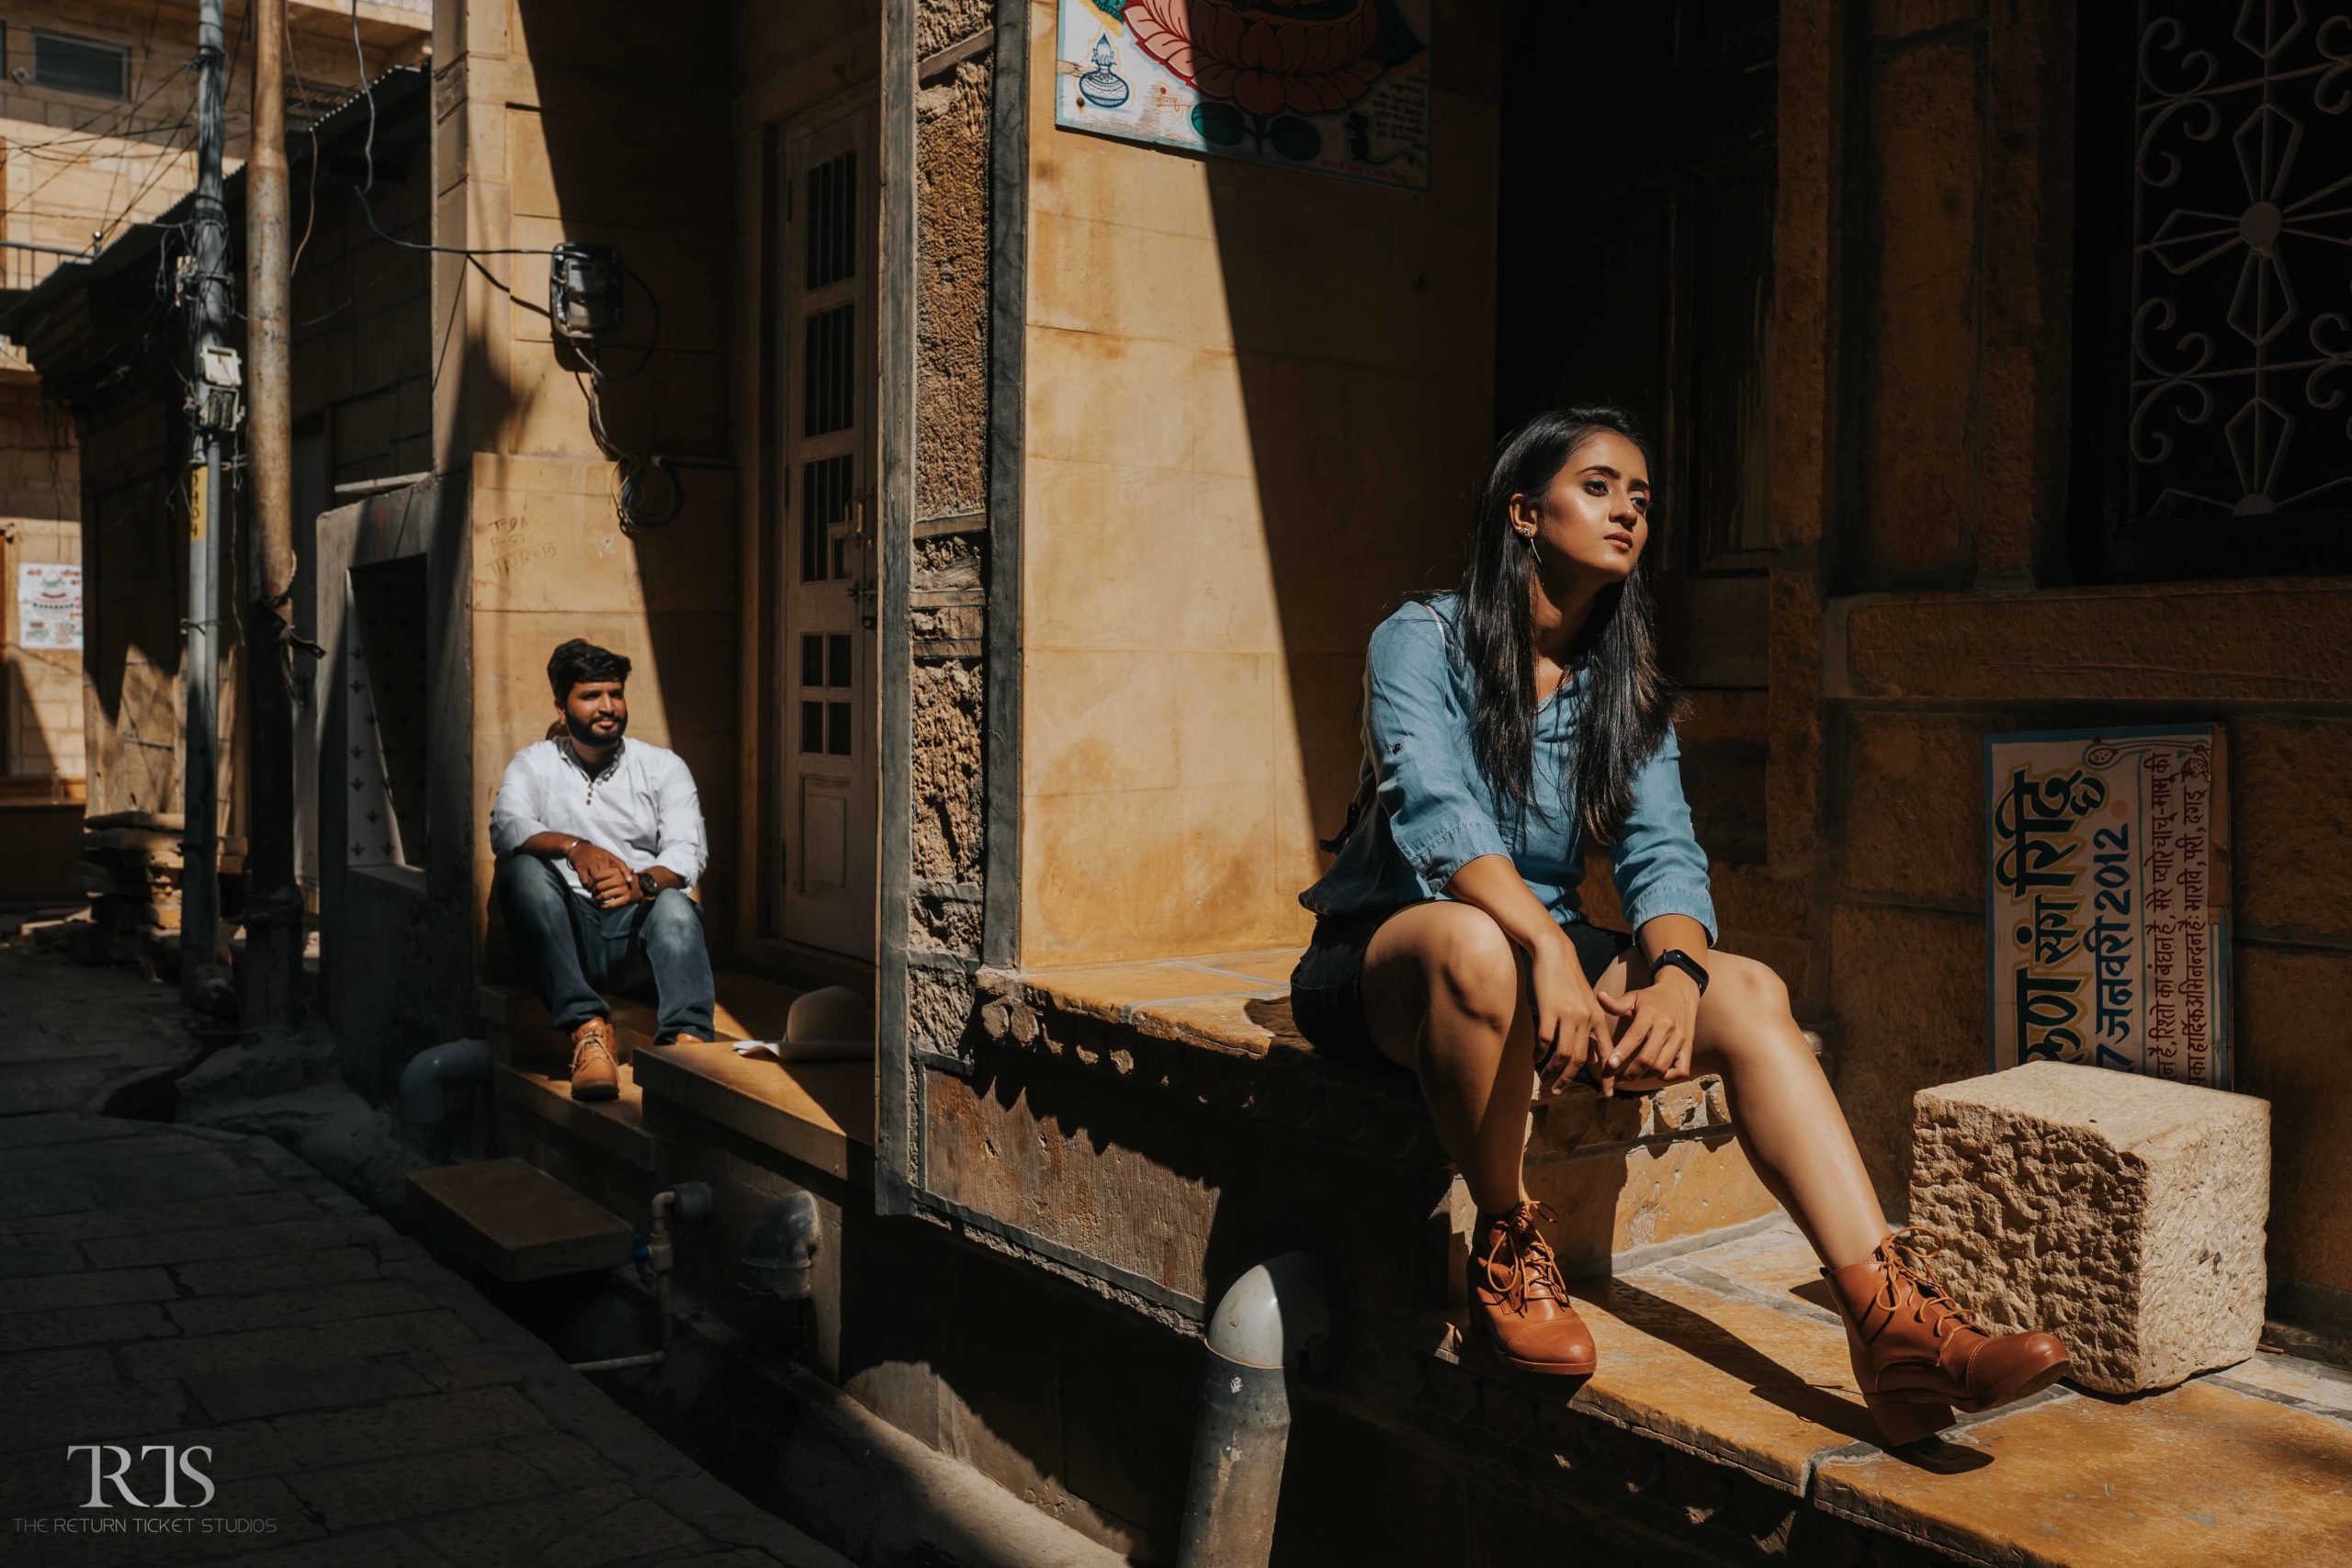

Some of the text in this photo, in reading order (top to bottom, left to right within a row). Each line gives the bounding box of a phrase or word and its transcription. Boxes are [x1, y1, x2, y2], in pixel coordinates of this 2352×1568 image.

[2143, 751, 2171, 773] की
[2145, 886, 2173, 912] मेरे
[1996, 769, 2105, 1064] रूण संग रिद्धि
[2084, 823, 2133, 1074] 7 जनवरी 2012
[2154, 976, 2174, 998] का
[2148, 999, 2175, 1042] रिश्तो
